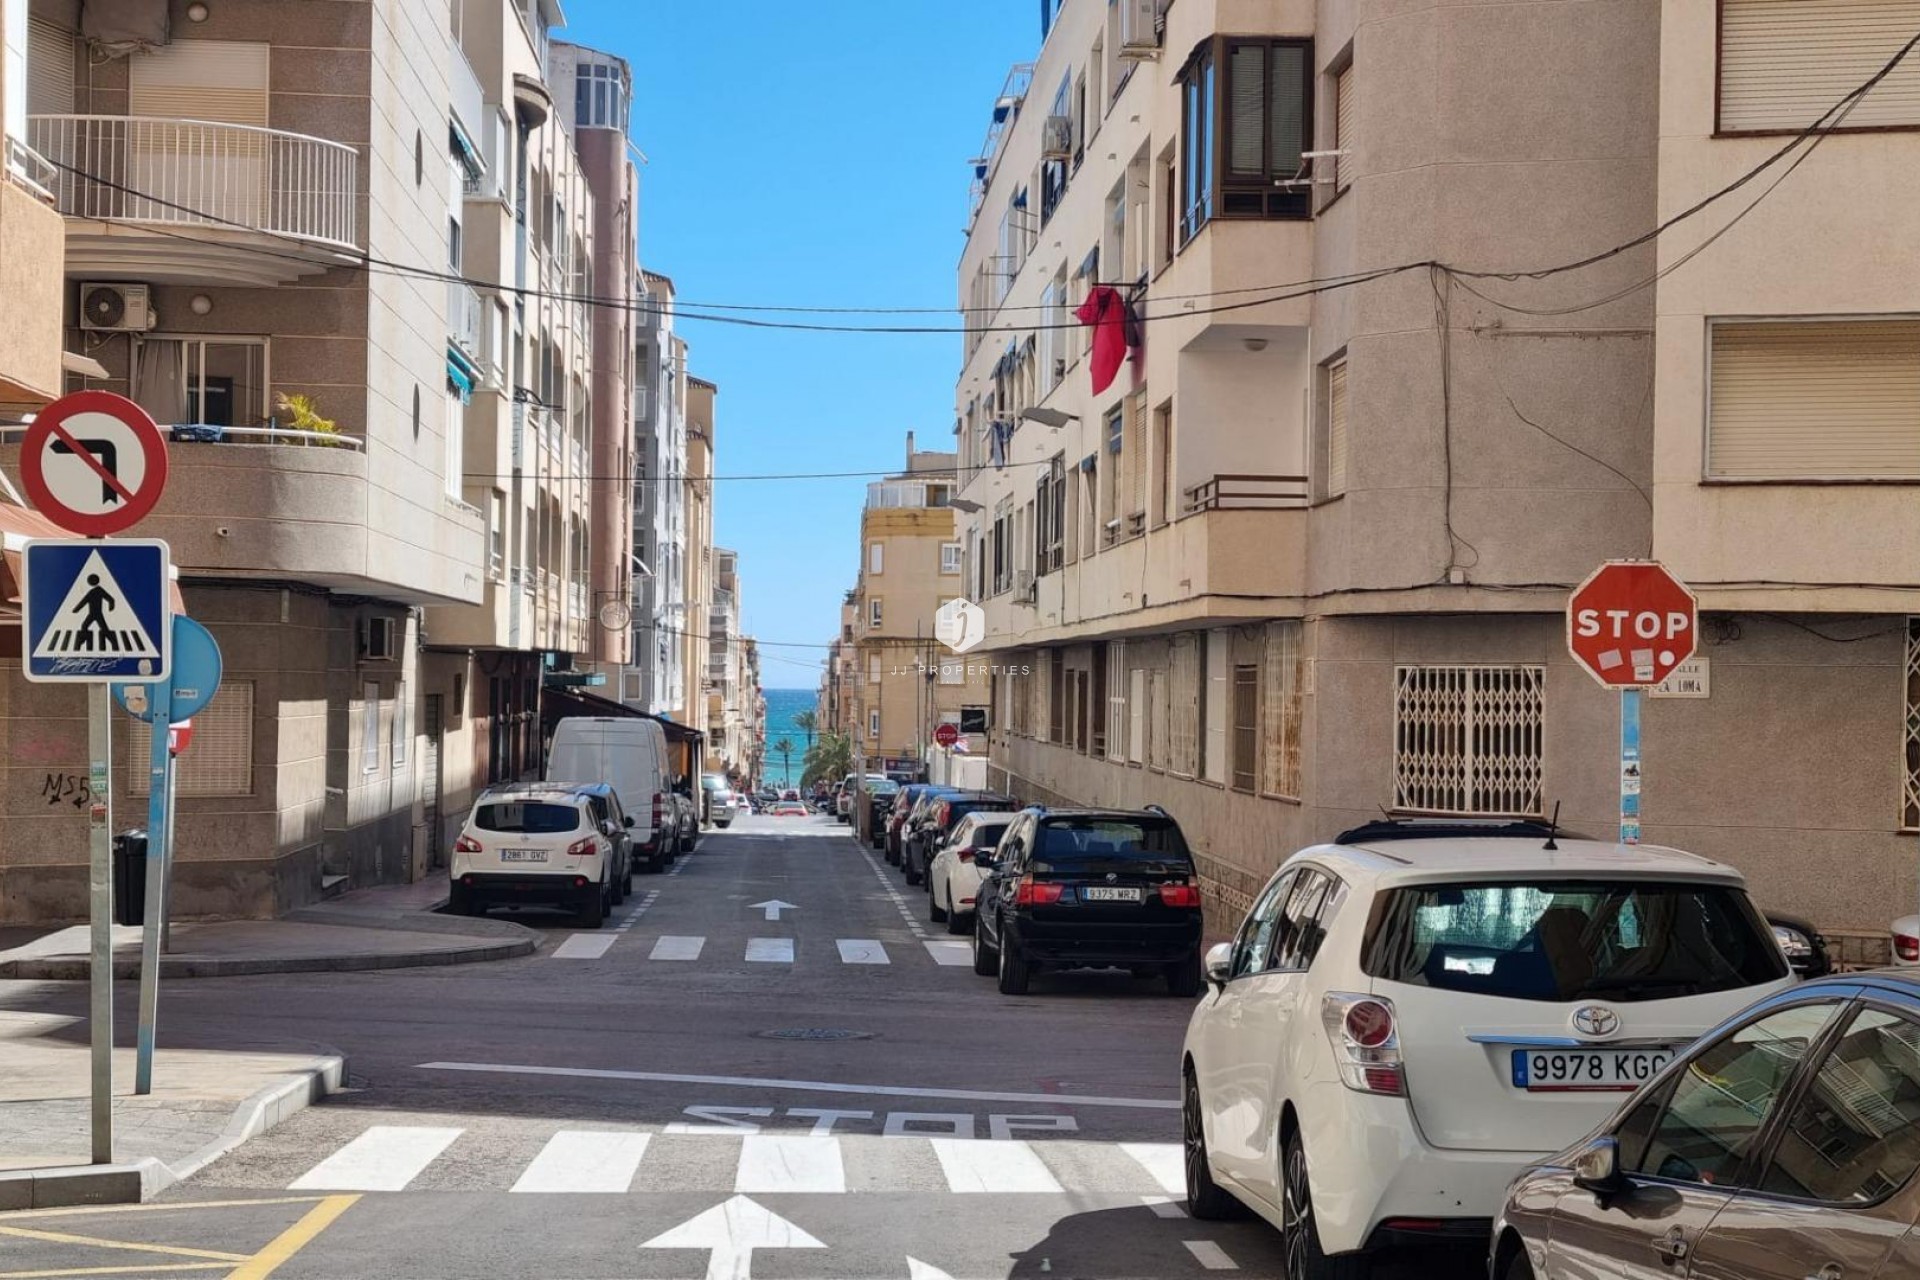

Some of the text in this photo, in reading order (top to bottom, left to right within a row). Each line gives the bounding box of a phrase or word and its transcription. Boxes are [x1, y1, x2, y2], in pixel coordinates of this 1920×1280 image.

[1577, 609, 1689, 639] STOP
[1533, 1055, 1603, 1080] 9978
[662, 1105, 1079, 1140] STOP
